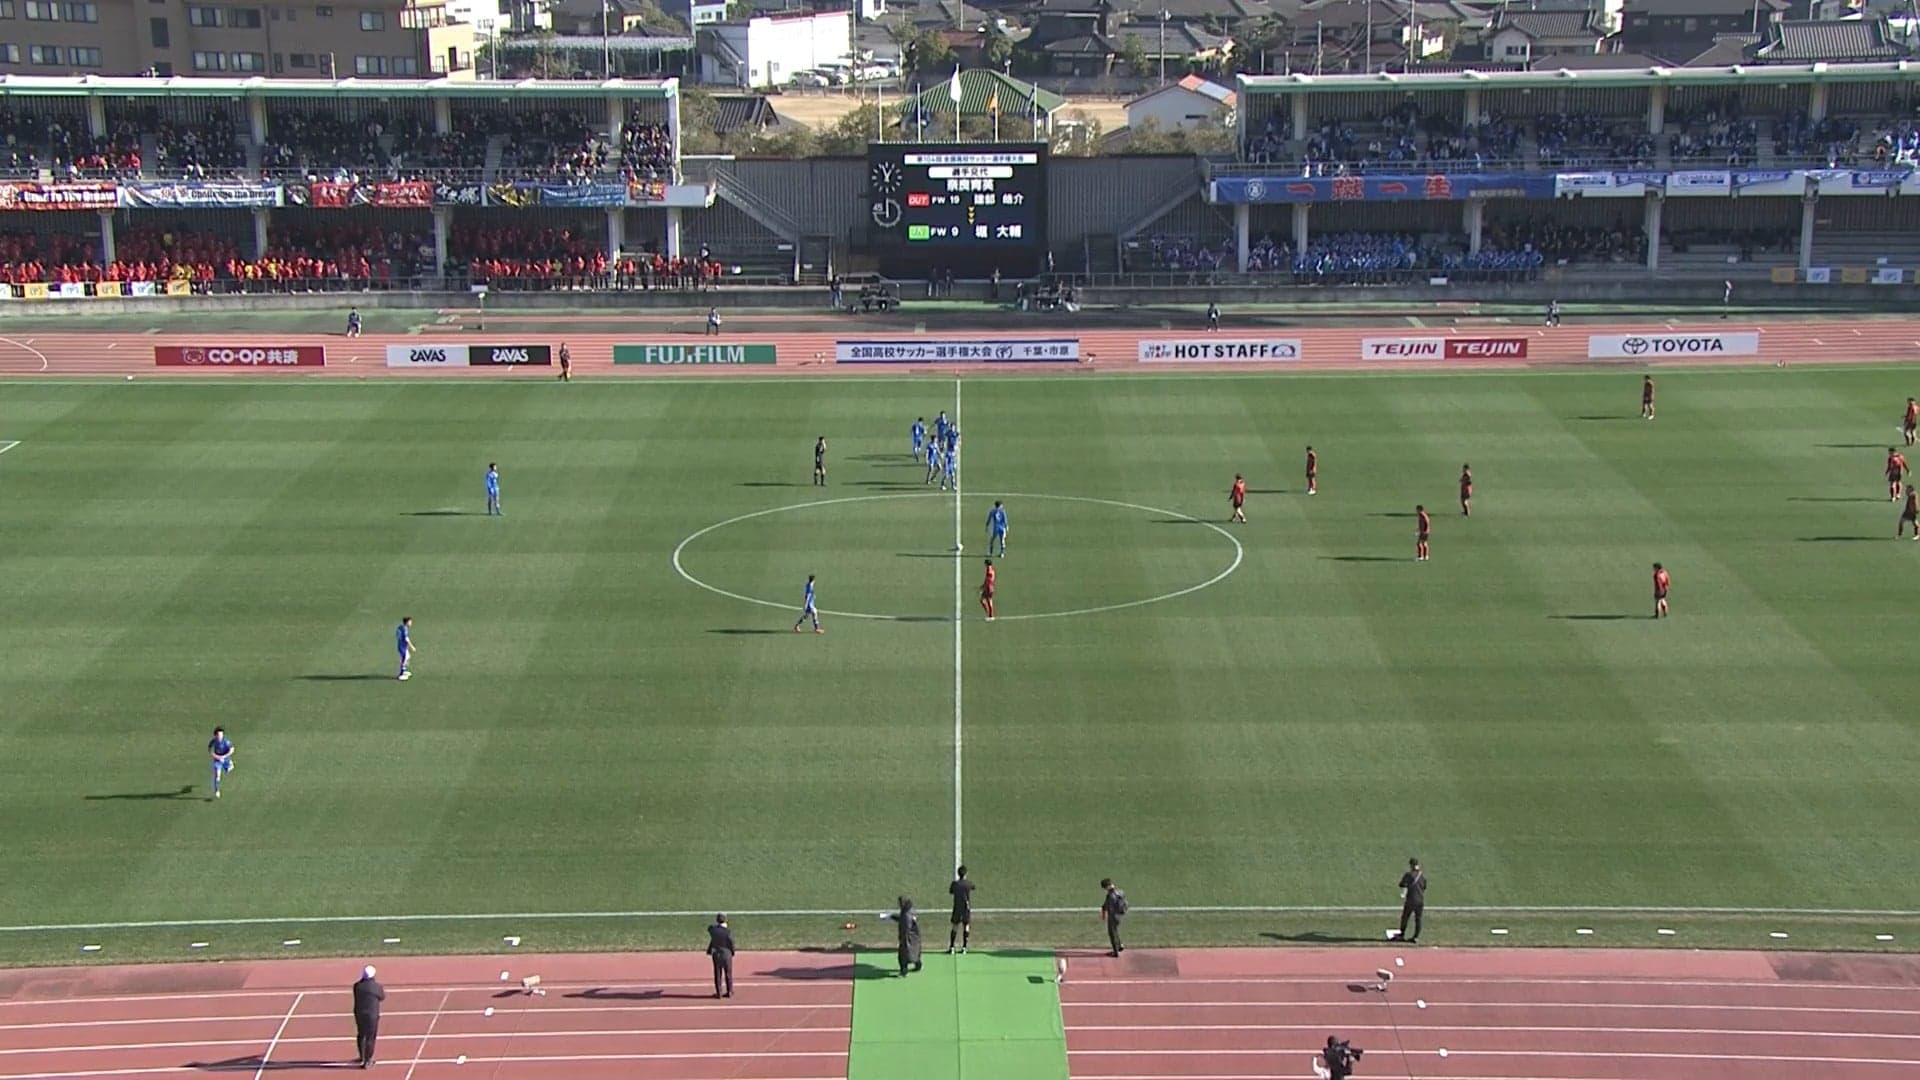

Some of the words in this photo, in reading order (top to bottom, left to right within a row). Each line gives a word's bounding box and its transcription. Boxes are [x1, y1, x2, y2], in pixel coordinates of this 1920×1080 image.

[952, 168, 989, 177] 選手交代
[851, 345, 992, 358] 全国高校サッカー選手権大会
[1175, 344, 1211, 359] HOT
[1214, 344, 1269, 358] STAFF
[1370, 342, 1437, 357] TEIJIN
[1451, 341, 1522, 355] TEIJIN
[1651, 338, 1723, 352] TOYOTA
[645, 346, 745, 363] FUJIFILM
